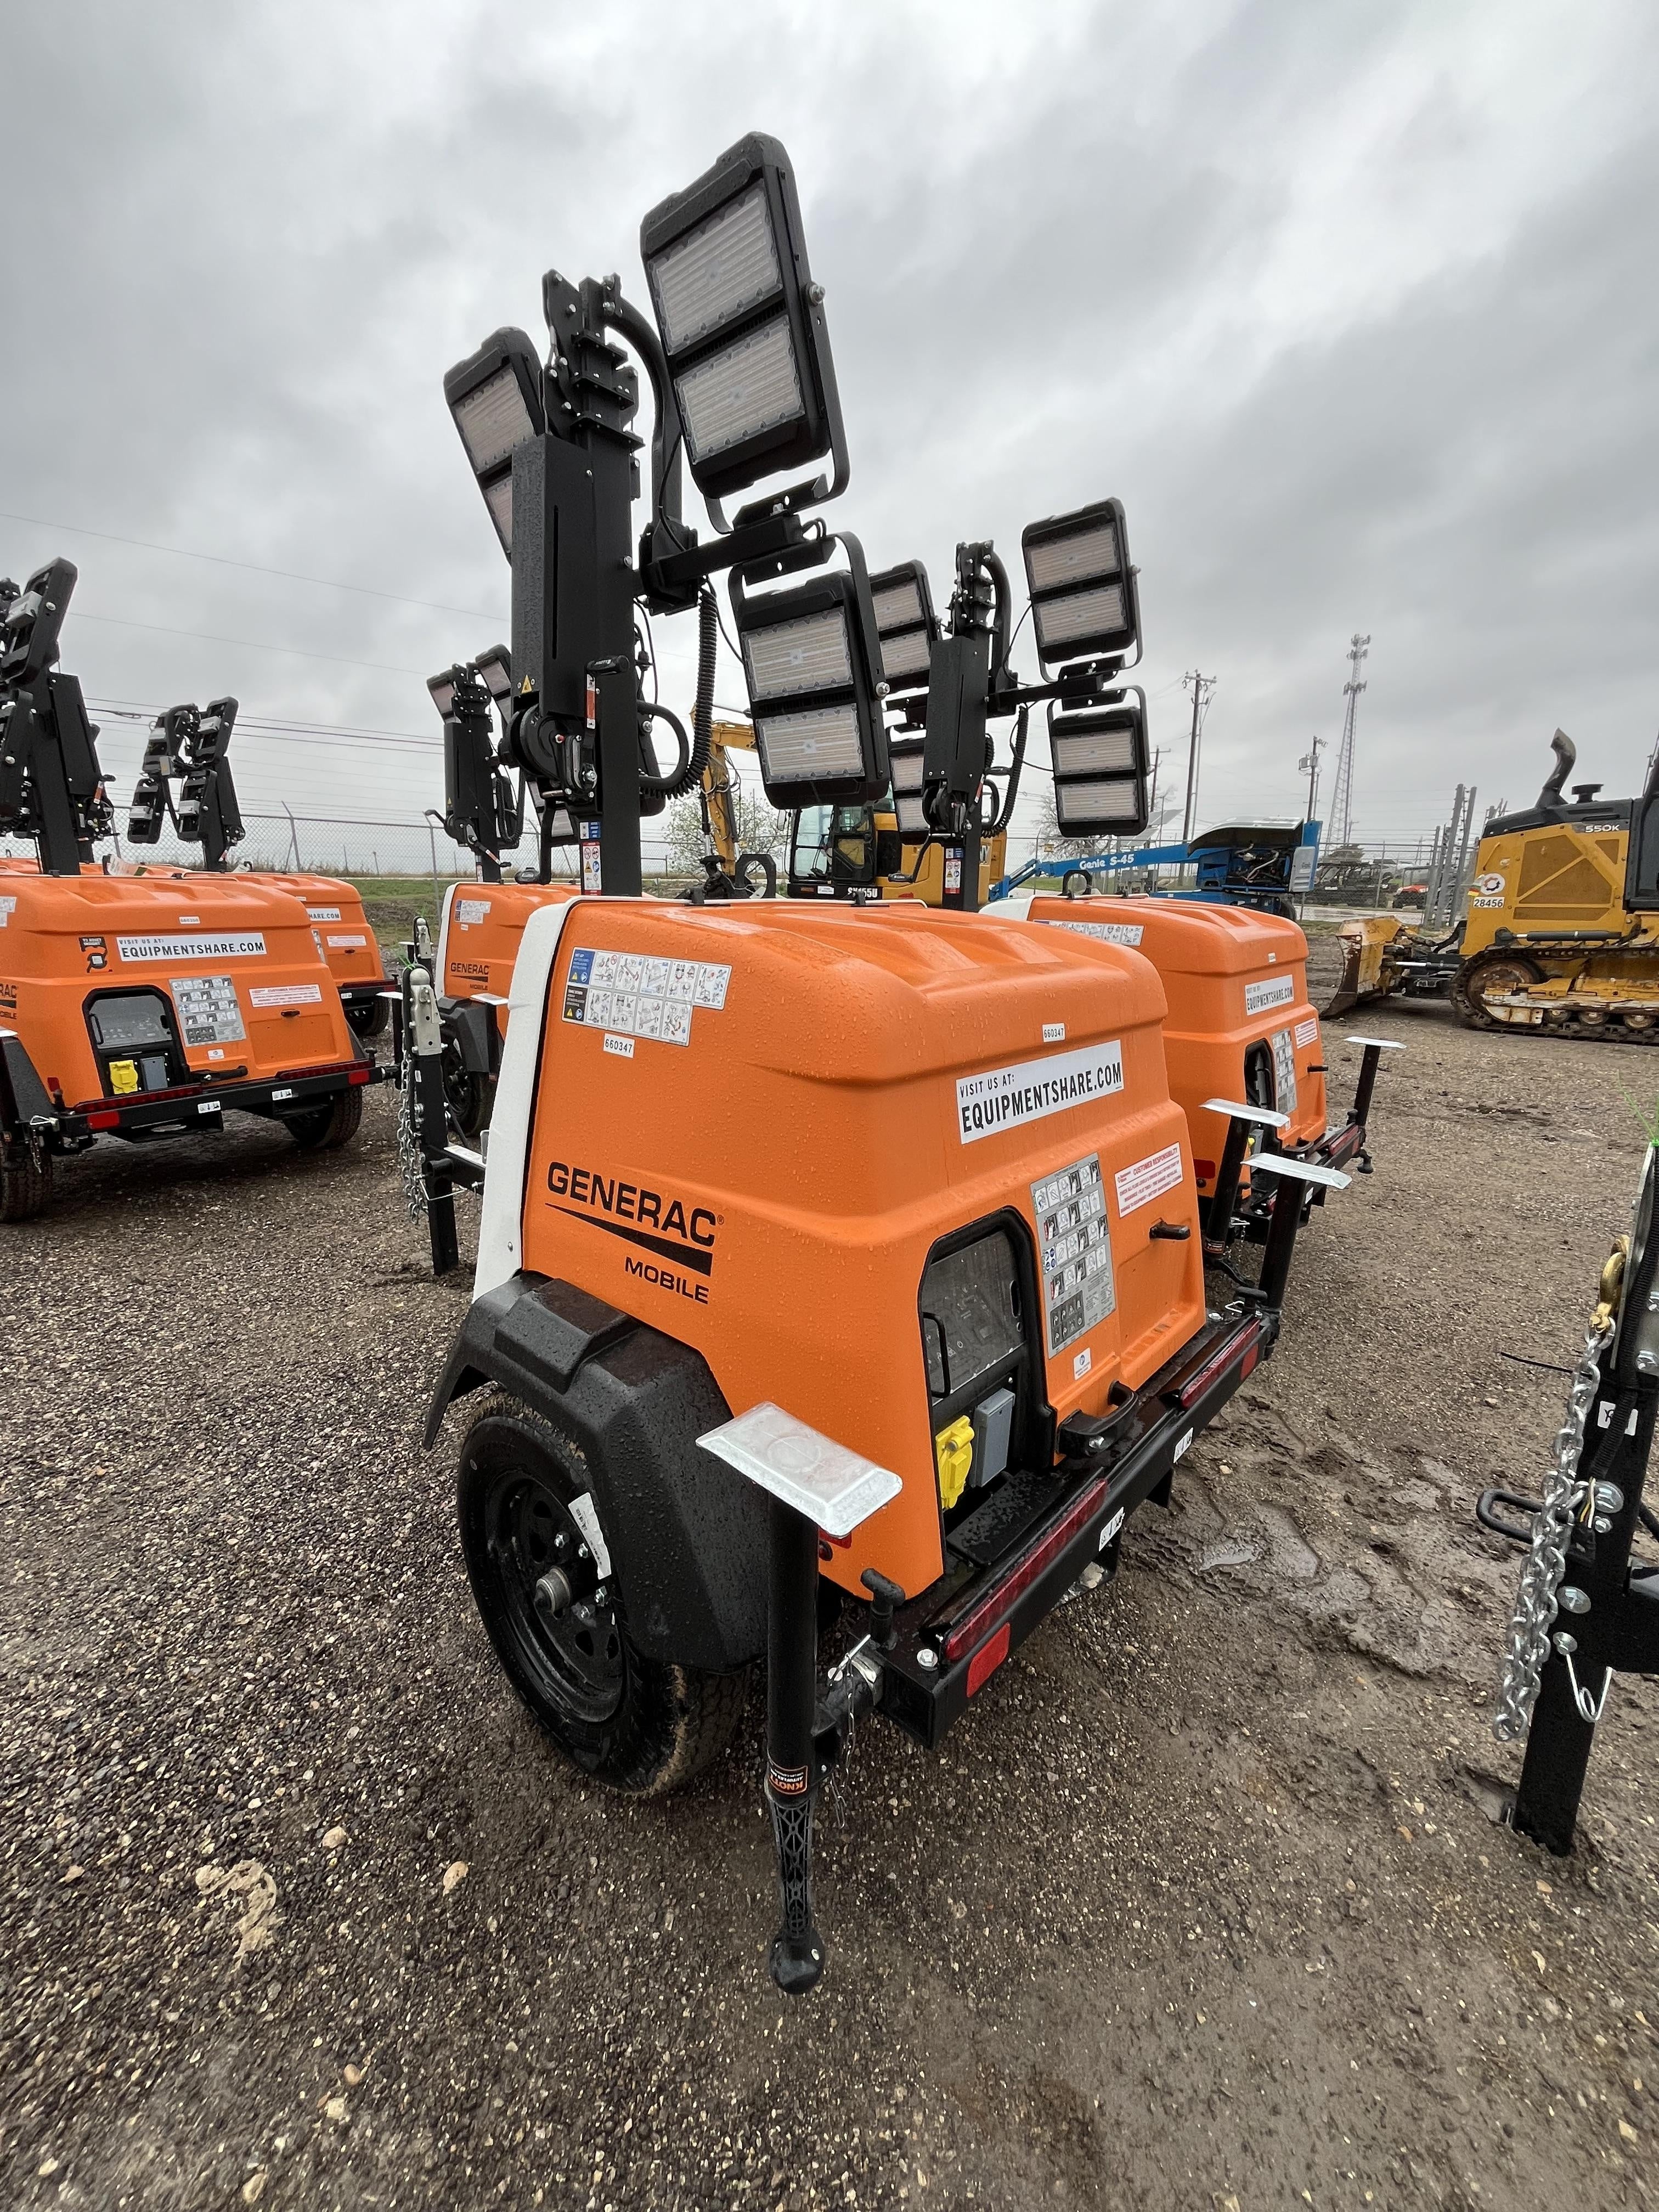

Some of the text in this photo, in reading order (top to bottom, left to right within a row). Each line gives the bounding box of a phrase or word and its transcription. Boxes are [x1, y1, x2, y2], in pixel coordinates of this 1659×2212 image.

[1585, 825, 1620, 833] 550K
[1079, 854, 1135, 870] Genie S-45
[1474, 899, 1503, 908] 28456
[121, 942, 264, 958] EQUIPMENTSHARE.COM
[450, 962, 489, 975] GENERAC
[1247, 986, 1293, 1010] EQUIPMENTSHARE.COM
[1044, 1028, 1064, 1039] 660347
[605, 1039, 633, 1053] 660347
[961, 1073, 1015, 1098] VISIT US AT:
[962, 1062, 1122, 1133] EQUIPMENTSHARE.COM
[548, 1161, 716, 1247] GENERAC
[625, 1256, 709, 1305] MOBILE
